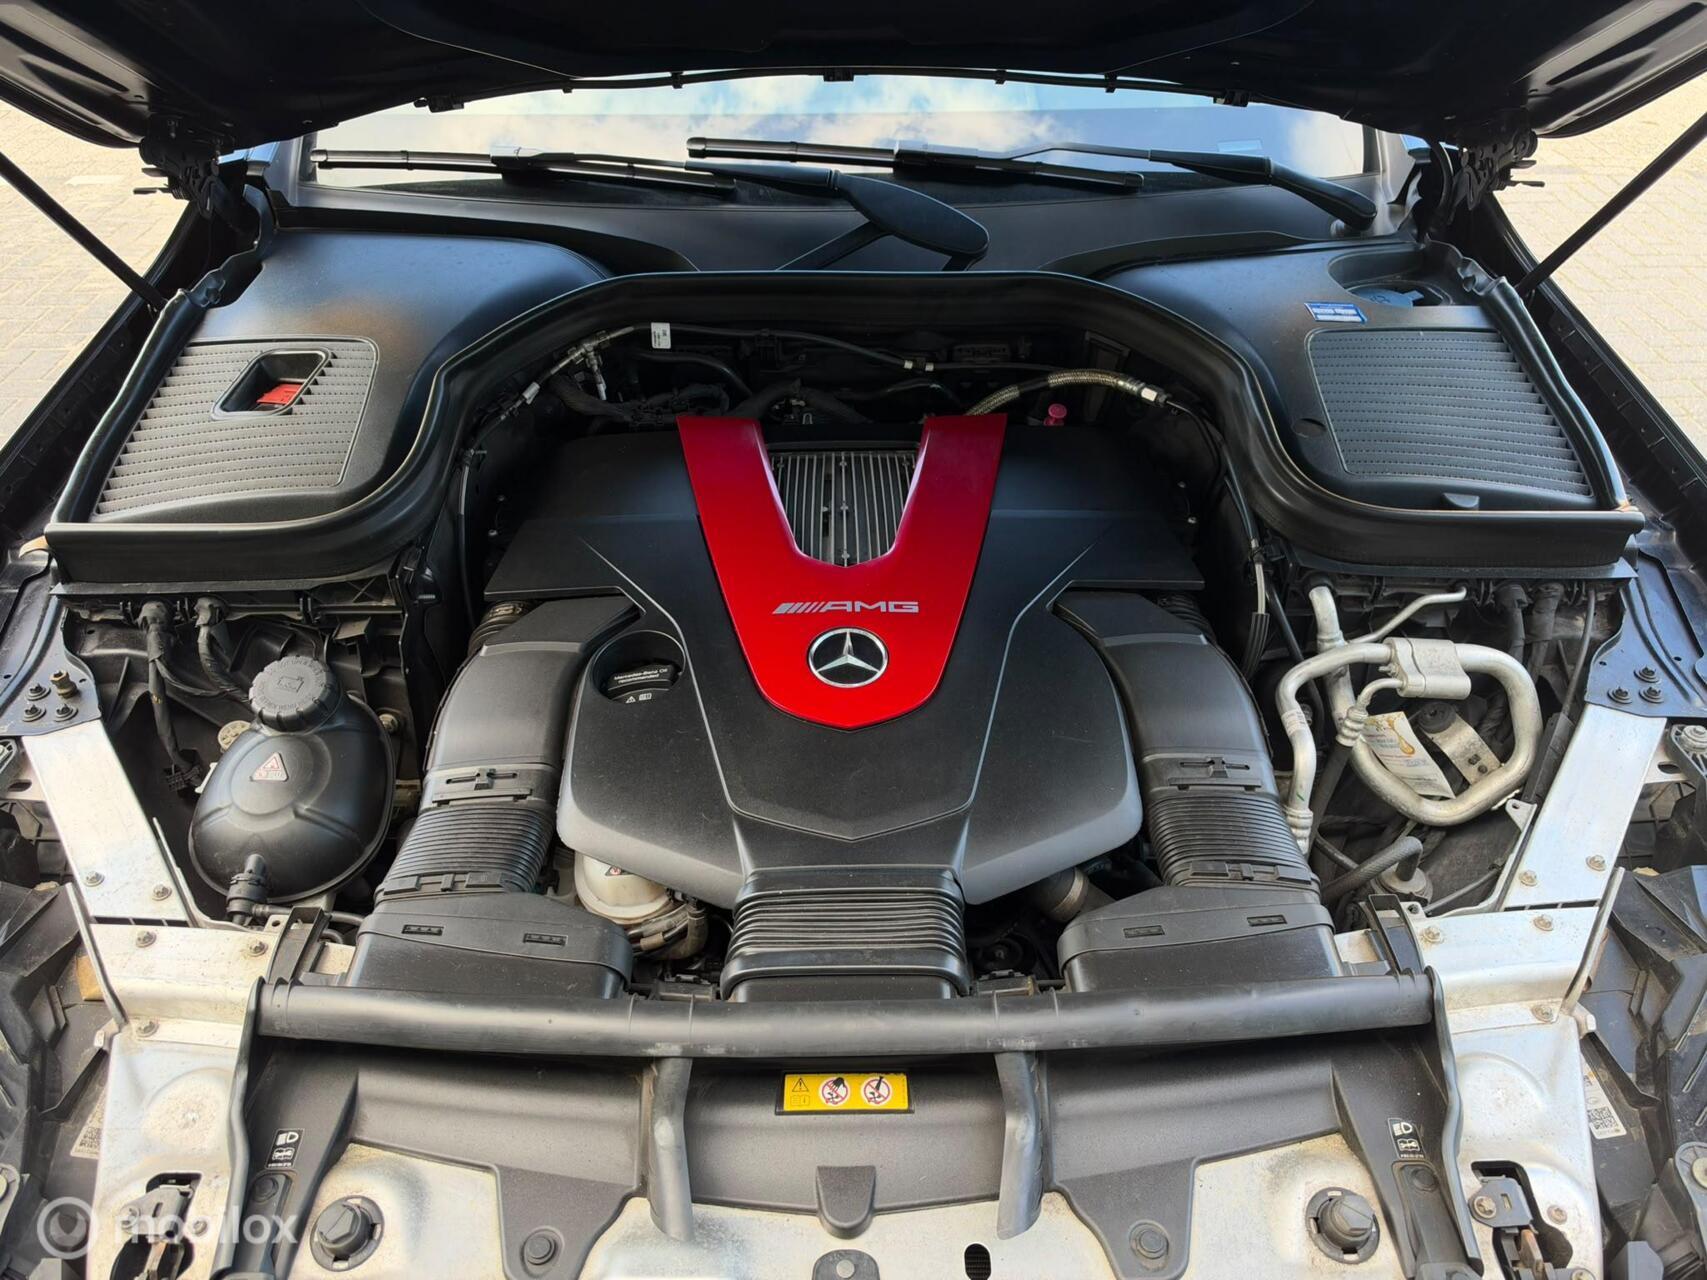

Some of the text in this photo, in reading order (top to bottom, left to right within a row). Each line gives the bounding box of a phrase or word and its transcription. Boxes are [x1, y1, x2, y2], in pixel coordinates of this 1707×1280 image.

[819, 601, 919, 613] AMG
[614, 670, 658, 680] Mercedes-Benz
[618, 674, 659, 684] recommended
